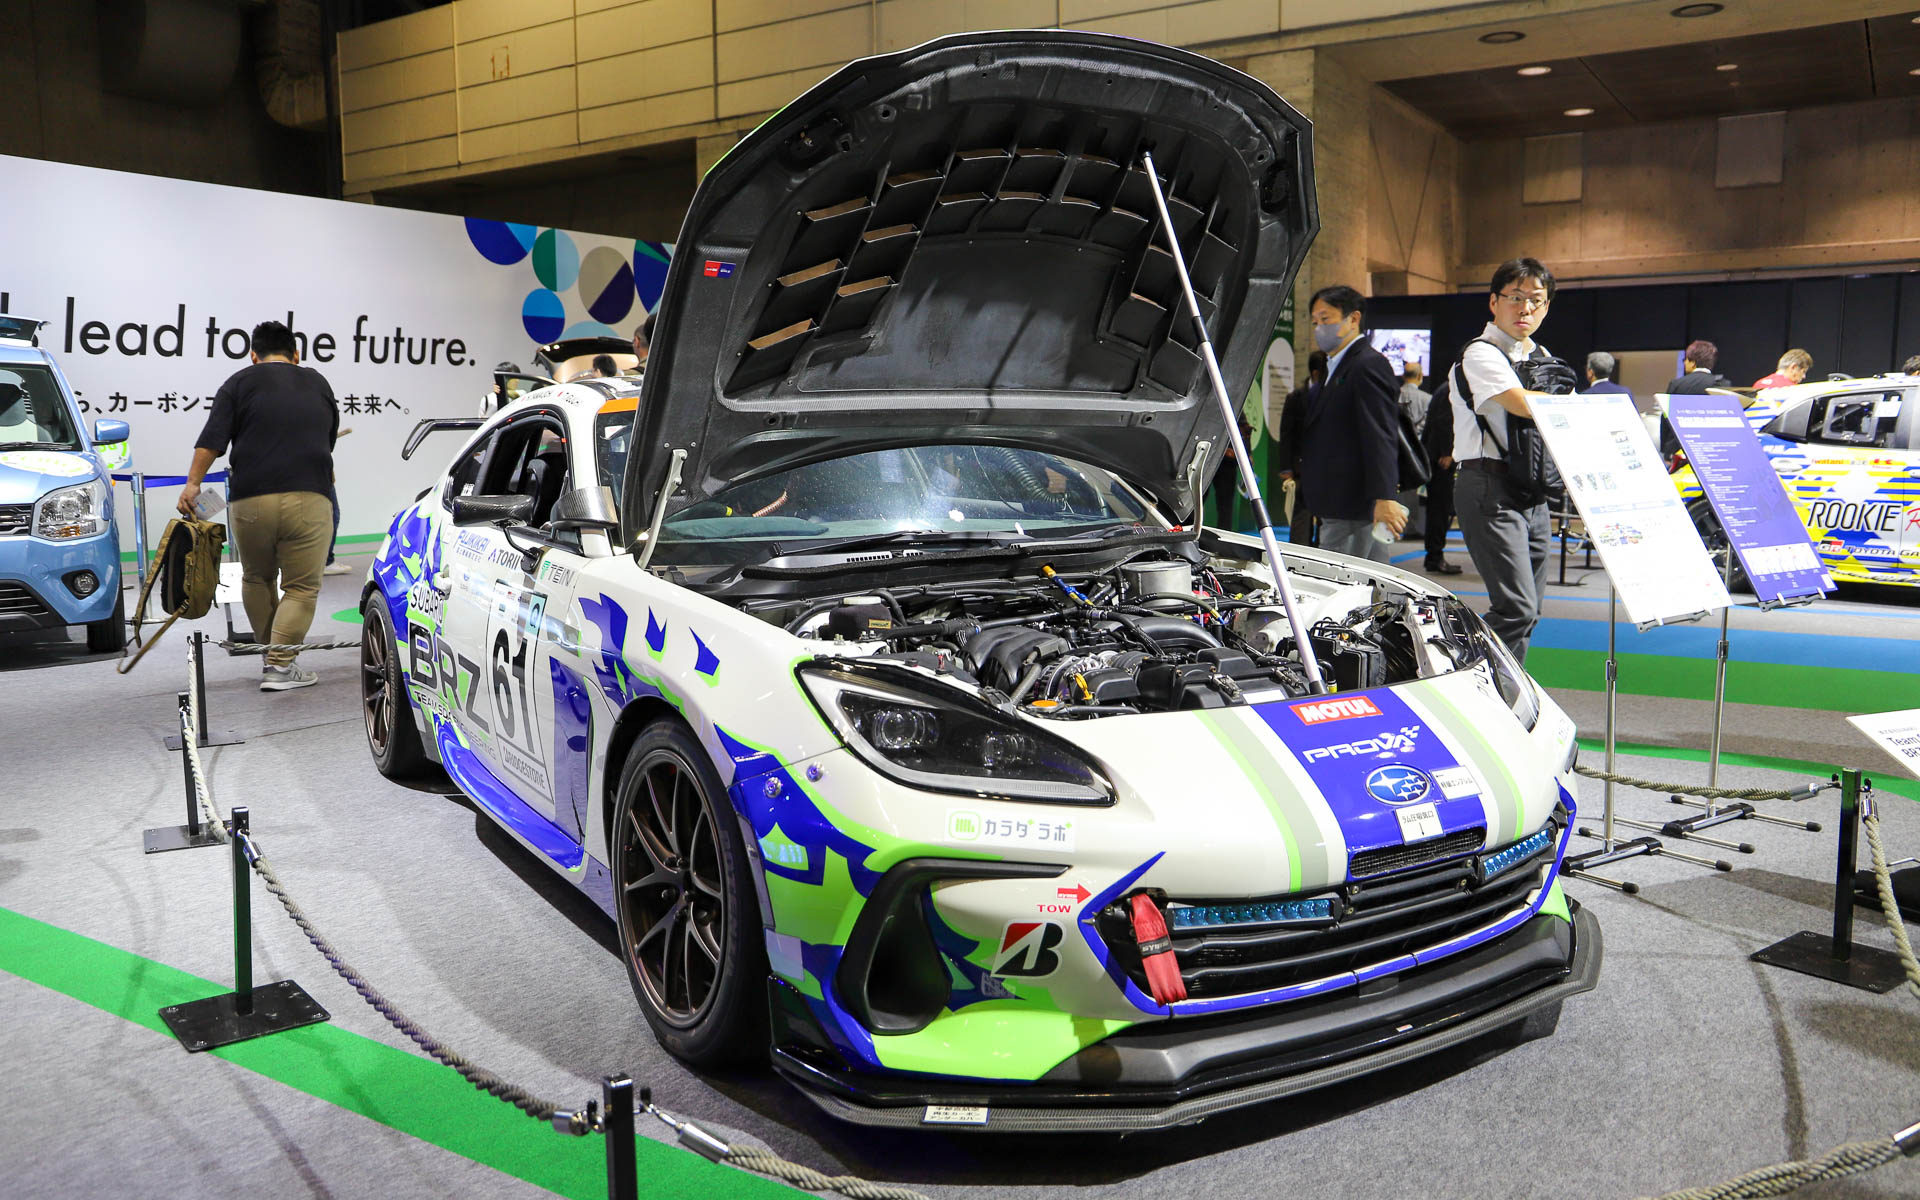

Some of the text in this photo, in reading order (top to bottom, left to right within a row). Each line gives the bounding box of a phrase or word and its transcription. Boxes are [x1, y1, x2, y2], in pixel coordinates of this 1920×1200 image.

[64, 296, 186, 357] lead
[206, 316, 250, 360] to
[286, 310, 336, 362] he
[353, 314, 475, 366] future.
[1808, 501, 1902, 532] ROOKIE
[1847, 546, 1896, 556] TOYOTA
[409, 621, 490, 734] BRZ
[492, 627, 535, 755] 61
[1299, 698, 1377, 722] MOTUL
[1302, 733, 1416, 764] PROVA
[1036, 904, 1072, 914] TOW
